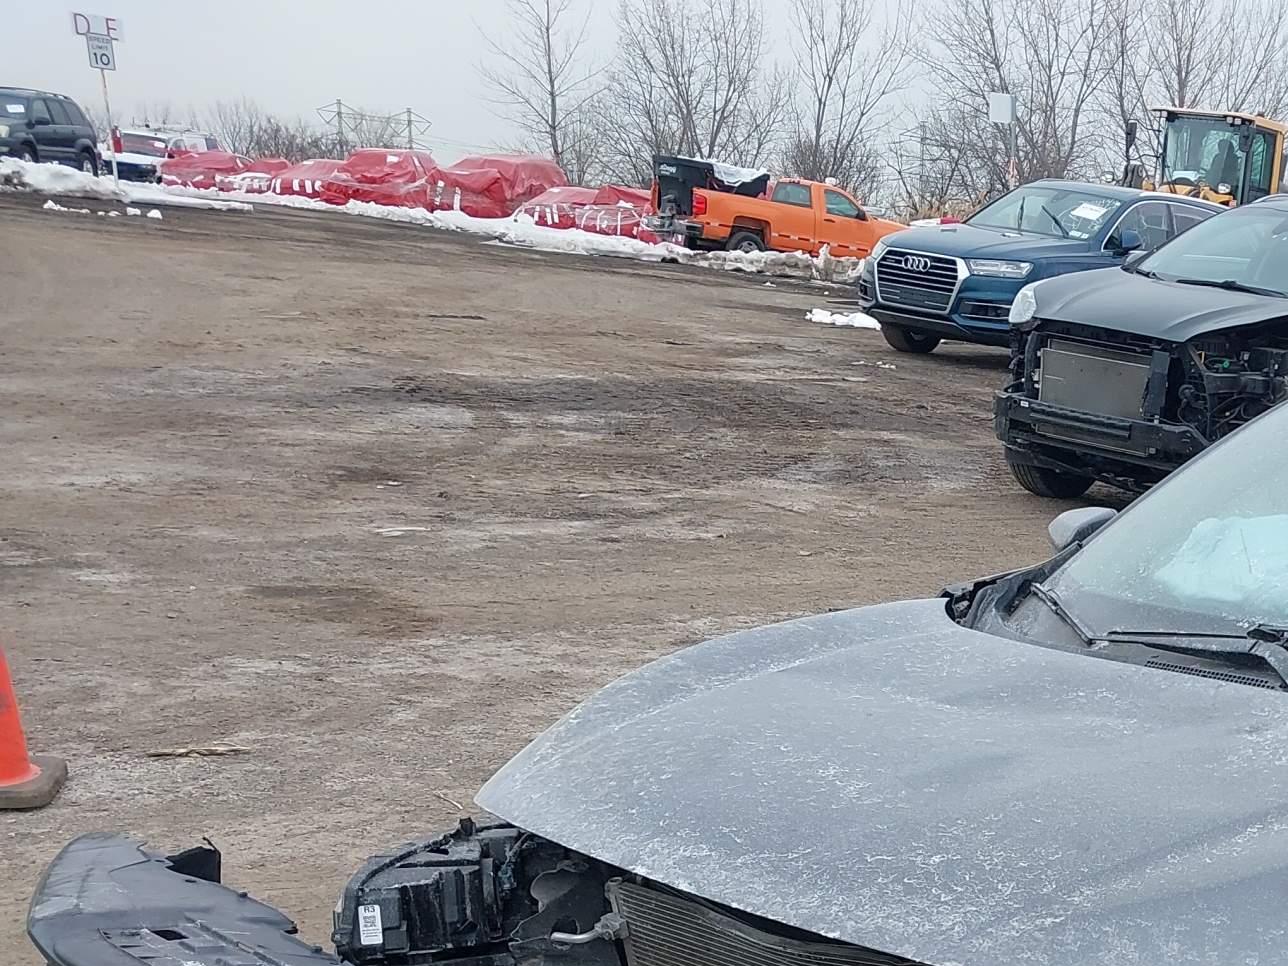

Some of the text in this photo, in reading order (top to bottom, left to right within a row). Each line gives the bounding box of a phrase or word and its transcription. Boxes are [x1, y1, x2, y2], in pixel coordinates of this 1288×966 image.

[73, 12, 90, 36] D
[93, 52, 111, 66] 10
[363, 904, 376, 914] R3
